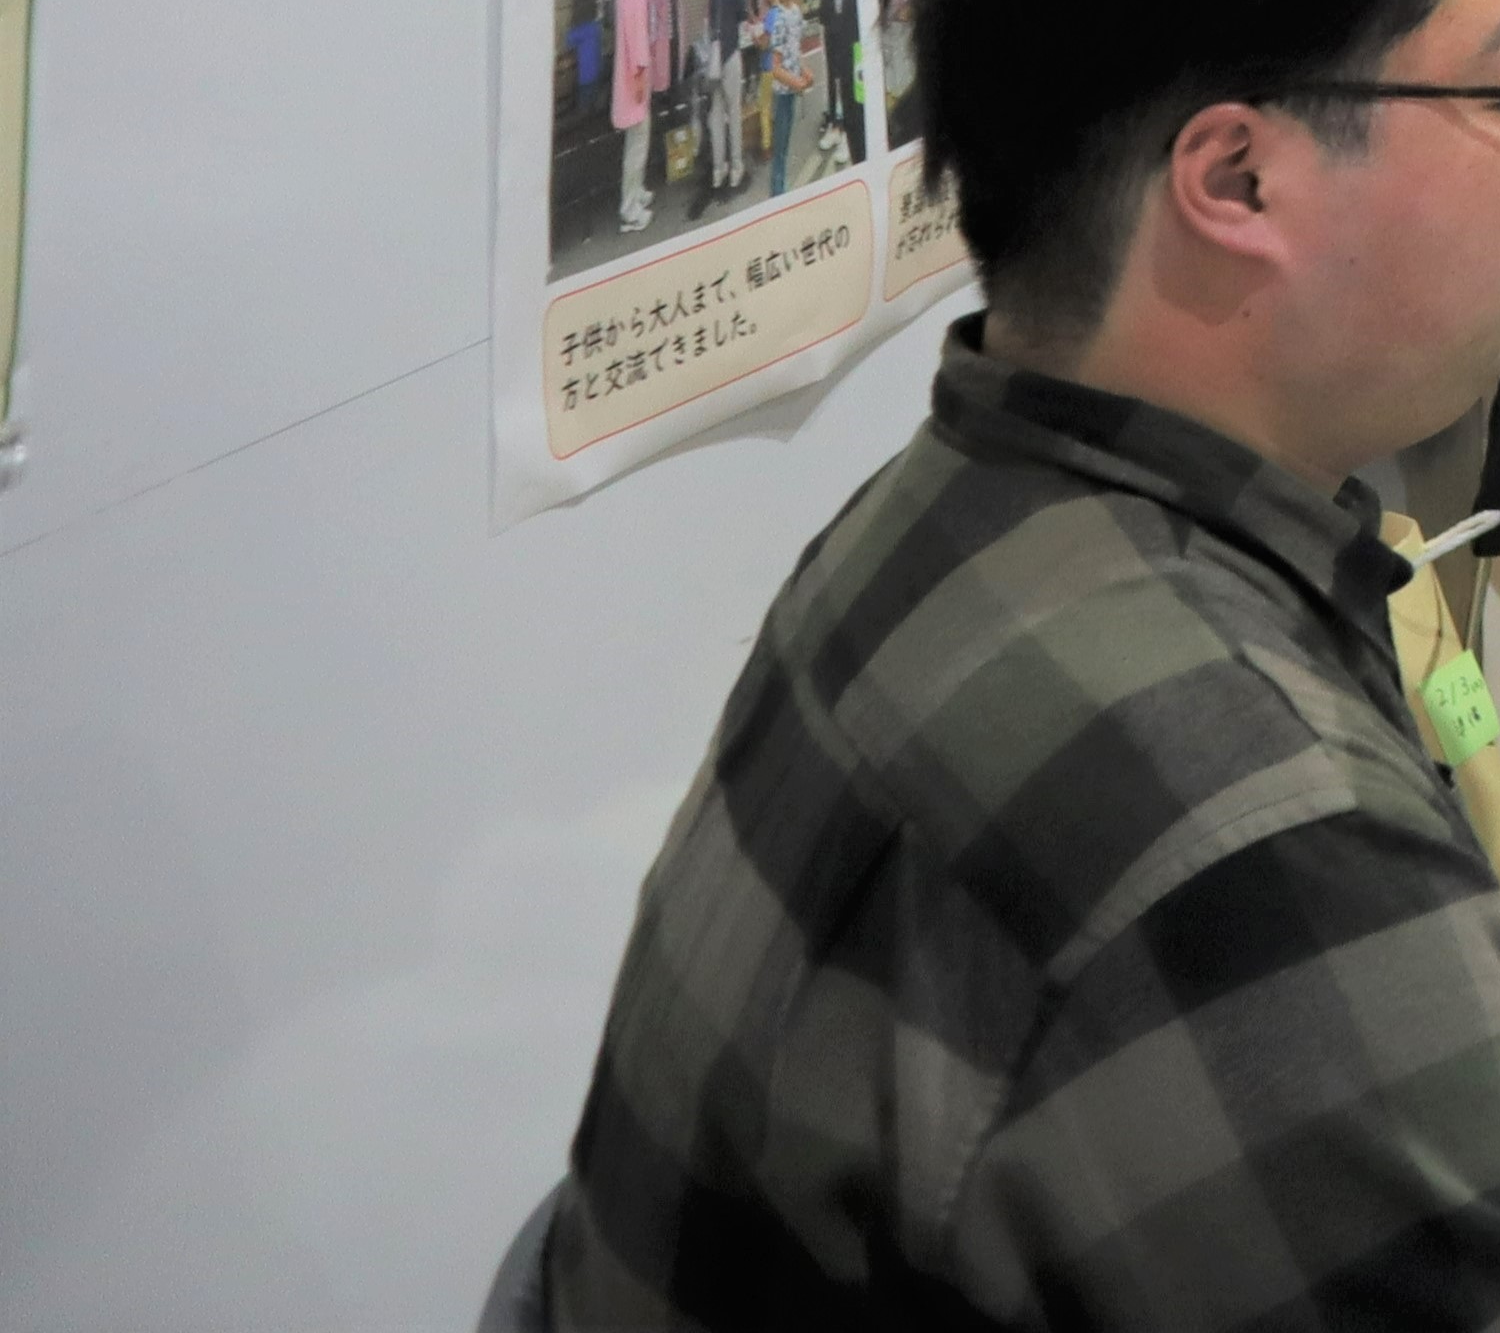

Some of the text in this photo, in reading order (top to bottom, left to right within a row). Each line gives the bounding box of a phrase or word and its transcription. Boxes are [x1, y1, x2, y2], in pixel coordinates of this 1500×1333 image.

[560, 223, 851, 367] 子供から大人まで、幅広い世代の
[562, 311, 758, 413] 方と交流できました。
